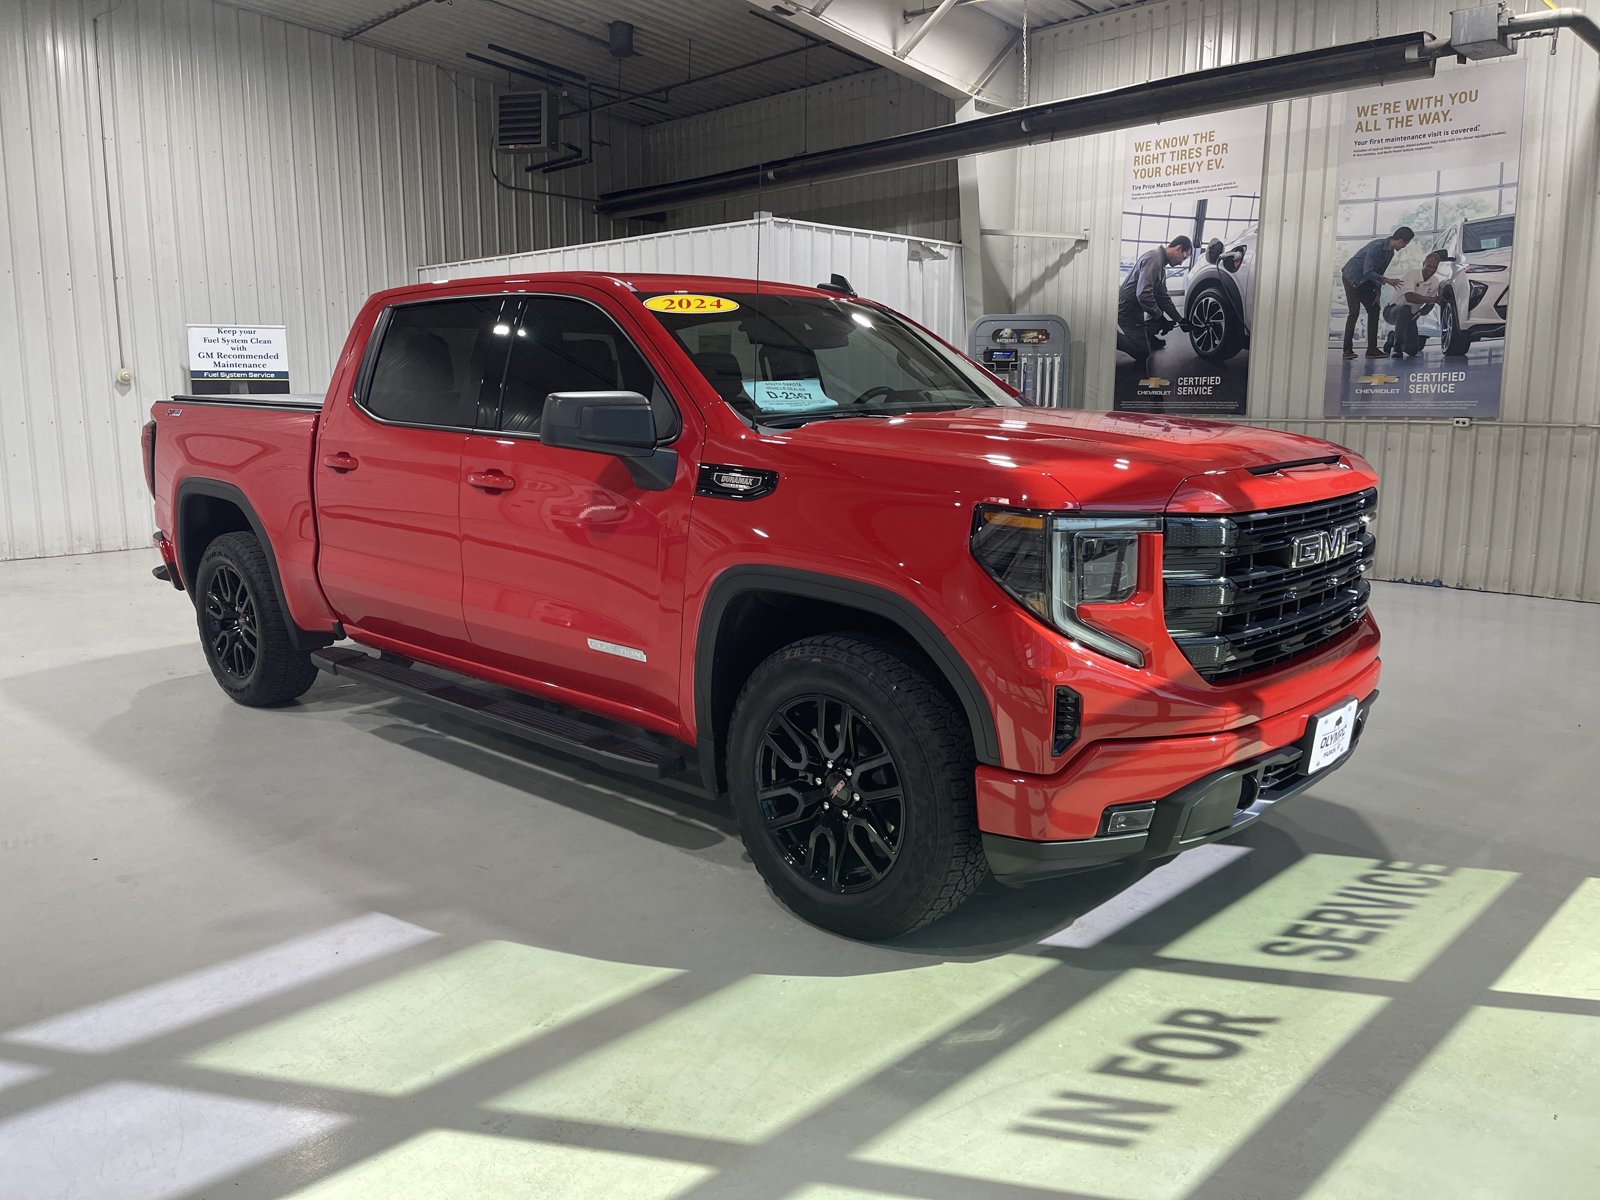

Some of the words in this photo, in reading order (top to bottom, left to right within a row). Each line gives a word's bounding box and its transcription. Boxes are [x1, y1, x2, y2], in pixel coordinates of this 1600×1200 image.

[1356, 101, 1401, 118] WE'RE
[1406, 95, 1444, 111] WITH
[1449, 90, 1478, 105] YOU
[1355, 120, 1381, 133] ALL
[1386, 115, 1413, 129] THE
[1418, 110, 1452, 126] WAY.
[1134, 140, 1151, 152] WE
[1156, 135, 1189, 150] KNOW
[1193, 130, 1215, 144] THE
[1385, 133, 1426, 143] maintenance
[1134, 152, 1166, 166] RIGHT
[1170, 147, 1201, 161] TIRES
[1206, 143, 1228, 156] FOR
[1133, 166, 1161, 179] YOUR
[1165, 161, 1203, 176] CHEVY
[1207, 158, 1224, 171] EV.
[1172, 179, 1200, 187] Guarantee.
[663, 298, 723, 310] 2024
[1177, 376, 1221, 385] CERTIFIED
[1409, 372, 1466, 382] CERTIFIED
[1177, 387, 1212, 395] SERVICE
[1409, 384, 1455, 393] SERVICE
[767, 391, 812, 400] D-2367
[721, 476, 753, 485] DURAMAX
[1291, 523, 1360, 568] GMC
[1007, 1090, 1177, 1148] IN
[1093, 1008, 1280, 1086] FOR
[1260, 860, 1454, 962] SERVICE
